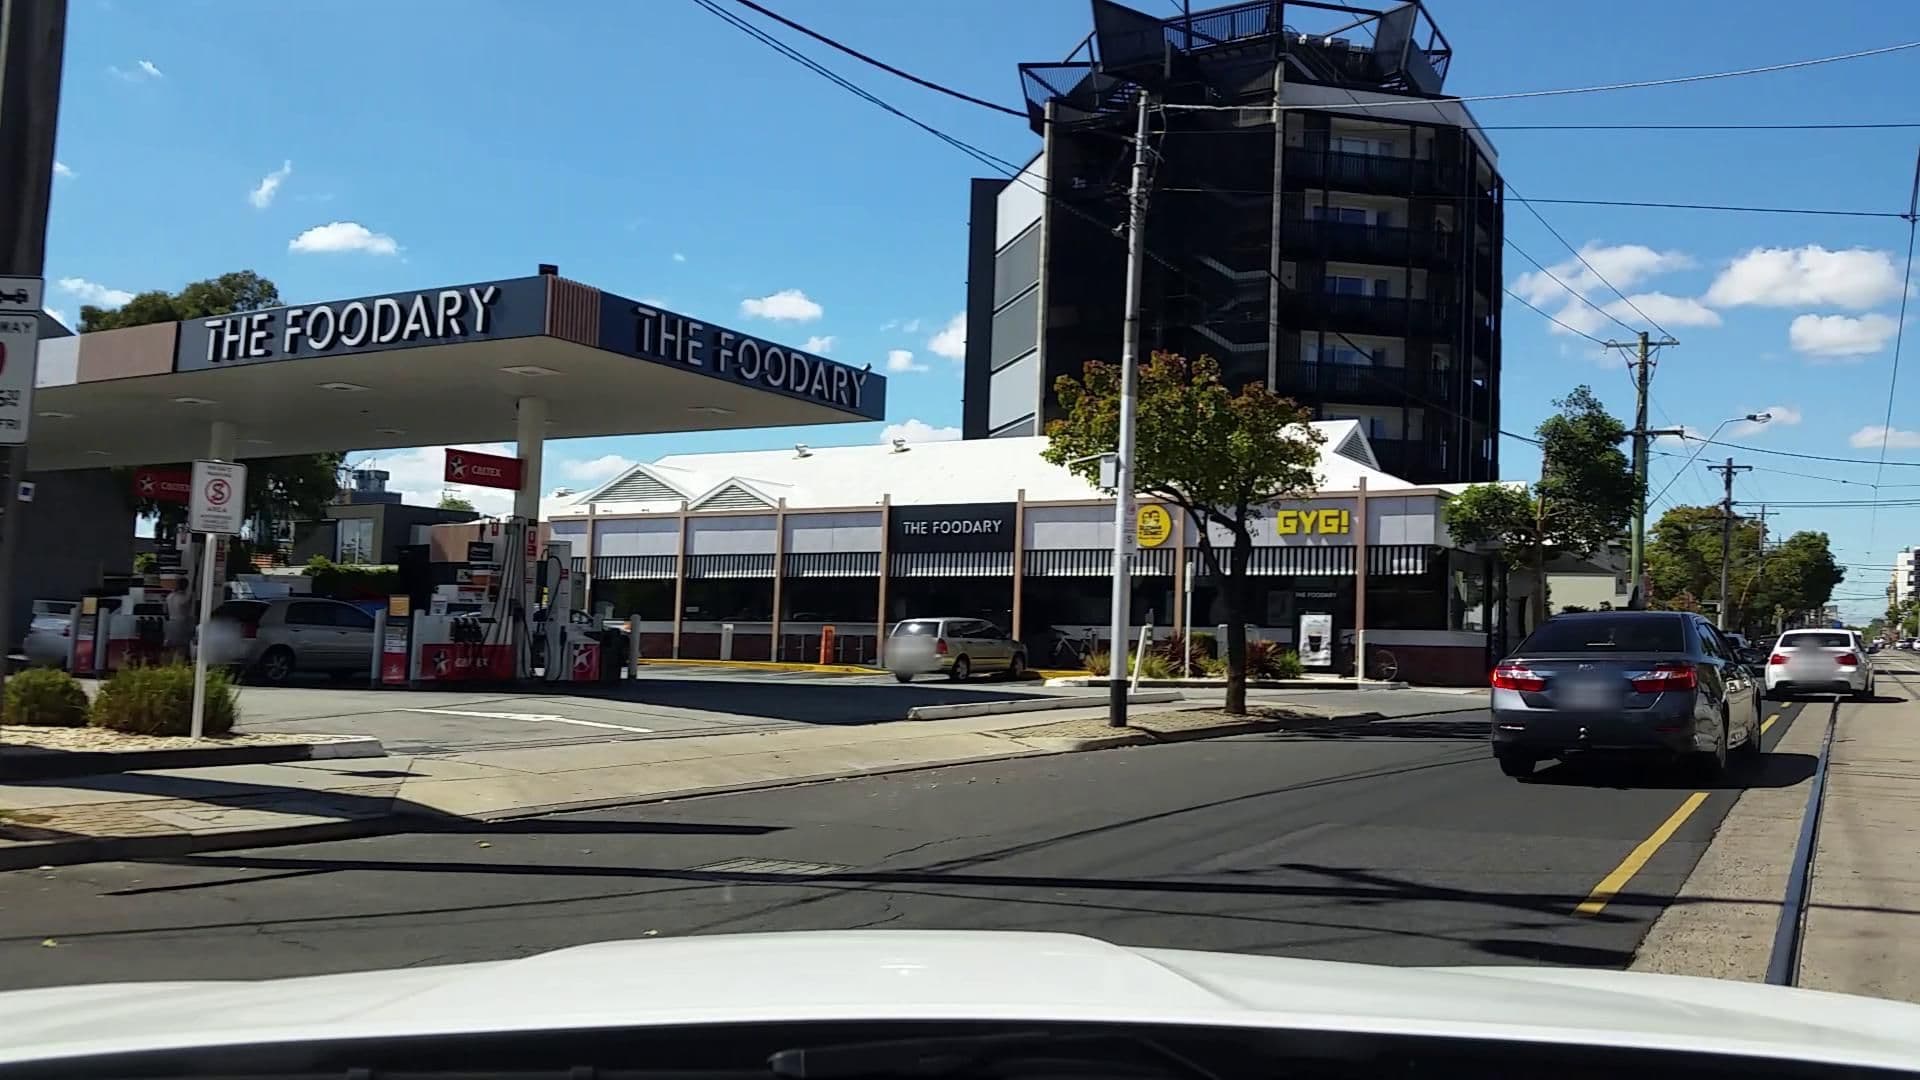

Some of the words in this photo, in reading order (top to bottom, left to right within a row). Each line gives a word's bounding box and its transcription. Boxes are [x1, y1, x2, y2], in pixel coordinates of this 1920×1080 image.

[204, 314, 269, 361] THE
[284, 285, 495, 352] FOODARY
[638, 307, 704, 366] THE
[719, 333, 867, 408] FOODARY
[903, 521, 928, 535] THE
[932, 519, 1002, 534] FOODARY
[1277, 509, 1350, 535] GYG!
